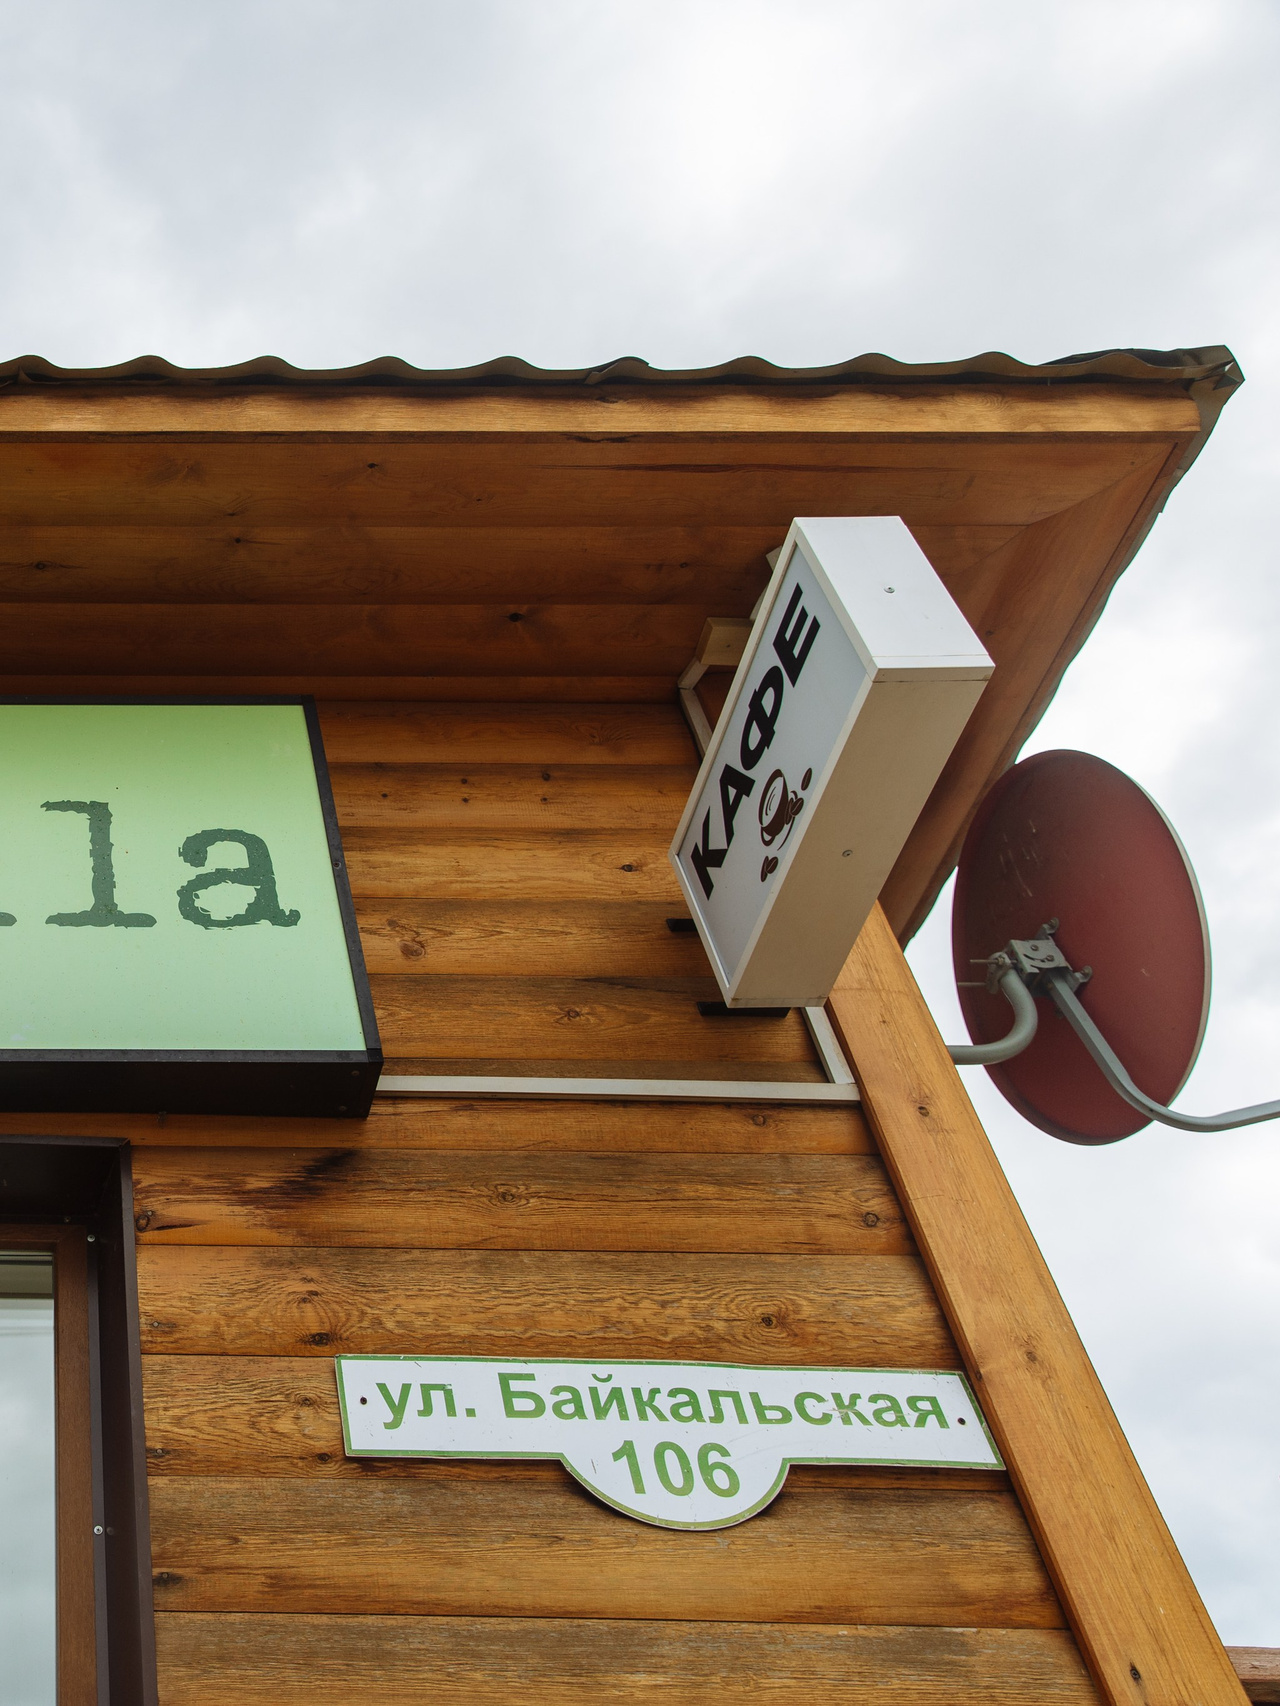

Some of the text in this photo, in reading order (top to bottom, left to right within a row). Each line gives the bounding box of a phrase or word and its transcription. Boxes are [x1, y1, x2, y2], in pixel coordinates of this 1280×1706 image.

[691, 582, 821, 901] КАФЕ
[375, 1372, 949, 1430] ул. Байкальская
[611, 1440, 741, 1498] 106
